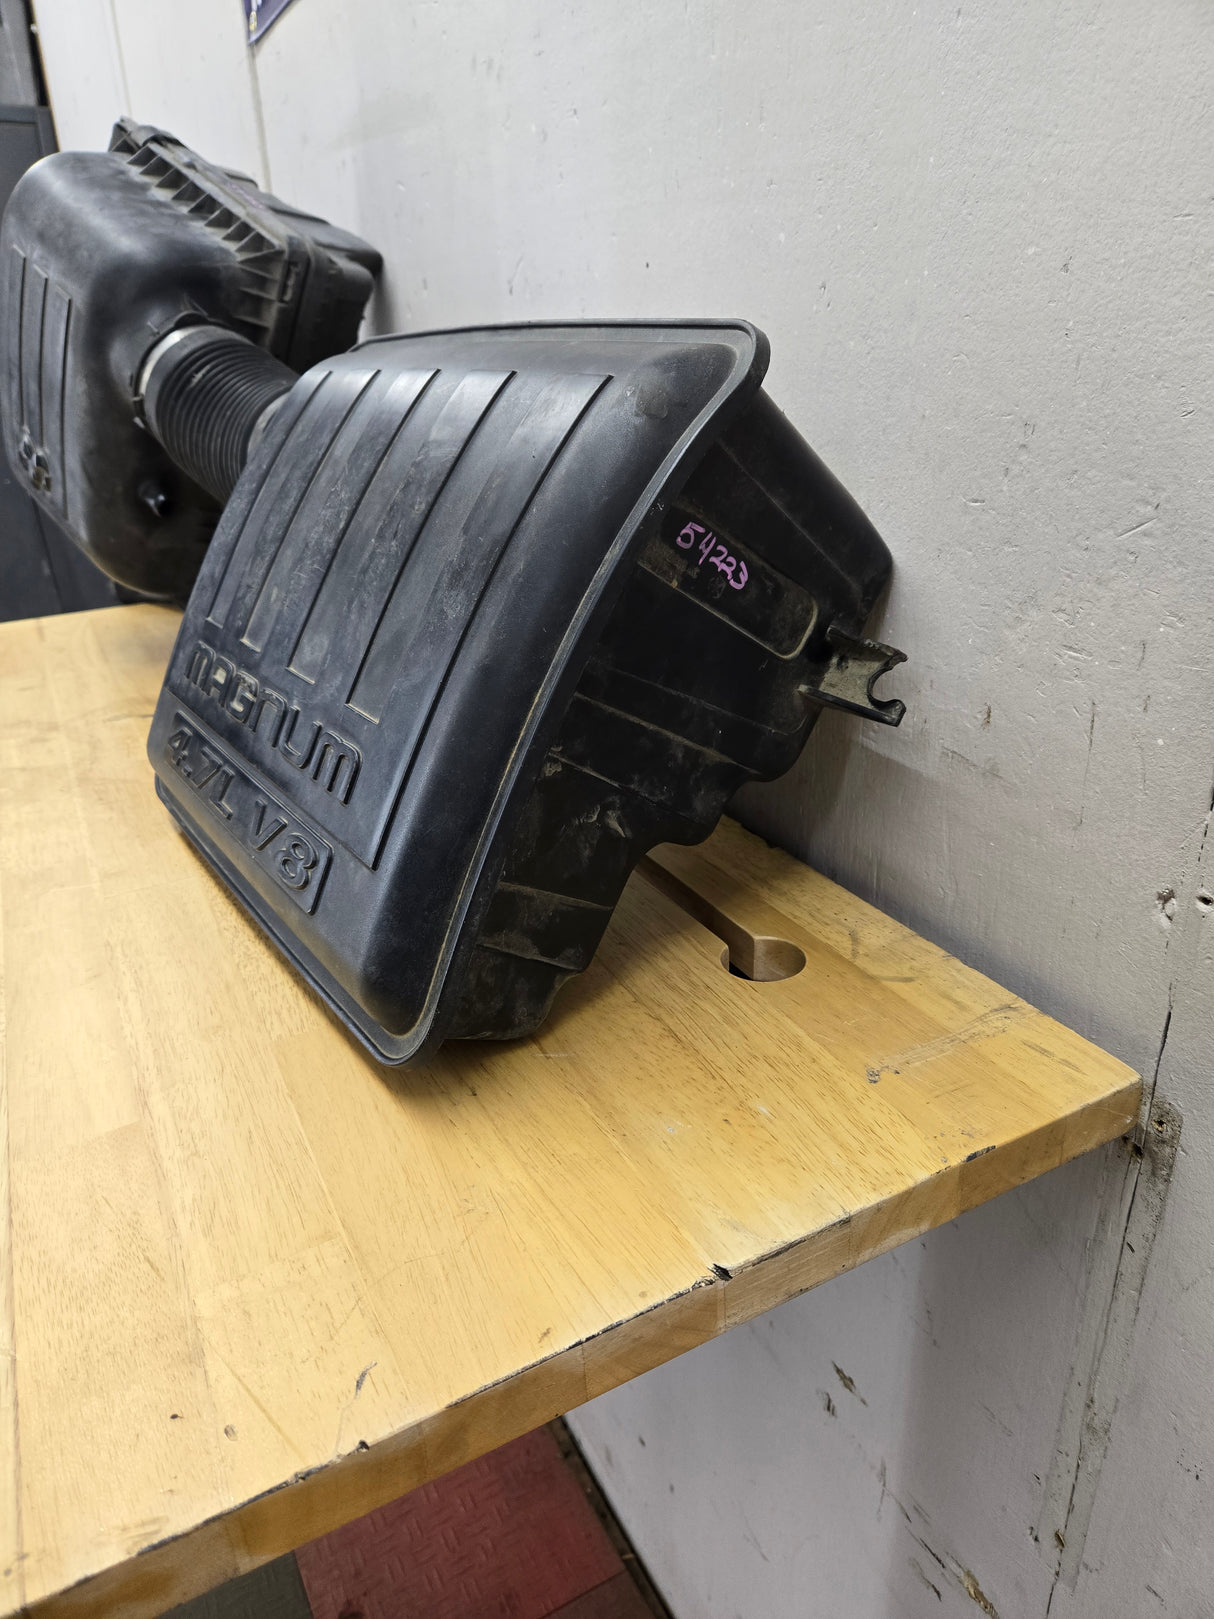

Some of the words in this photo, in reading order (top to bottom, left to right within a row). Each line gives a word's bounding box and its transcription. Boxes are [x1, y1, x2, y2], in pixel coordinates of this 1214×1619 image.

[676, 521, 748, 590] 54223
[166, 726, 236, 820] 4.7L
[249, 798, 320, 891] V8
